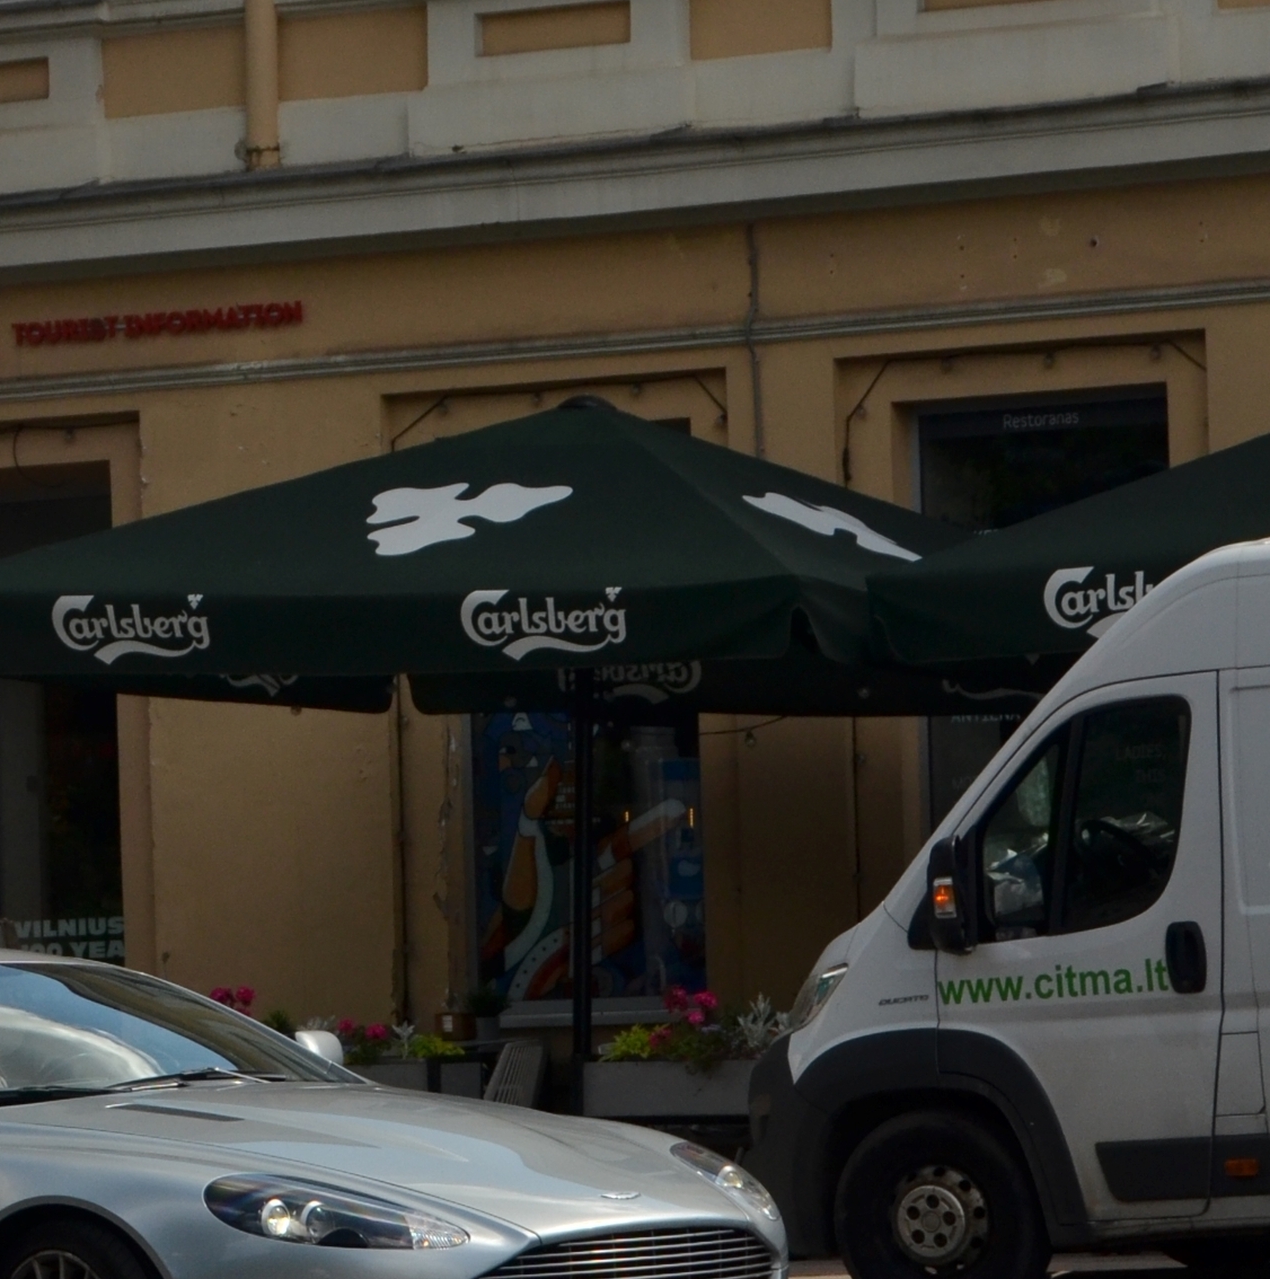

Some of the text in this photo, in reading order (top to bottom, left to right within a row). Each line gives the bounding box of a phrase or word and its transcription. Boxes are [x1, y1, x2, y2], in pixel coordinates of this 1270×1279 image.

[124, 300, 303, 338] INFORMATION
[1003, 412, 1078, 429] Restoranas
[51, 594, 210, 665] Carlsberg
[460, 588, 627, 661] Carlsberg
[937, 958, 1170, 1006] www.citma.lt
